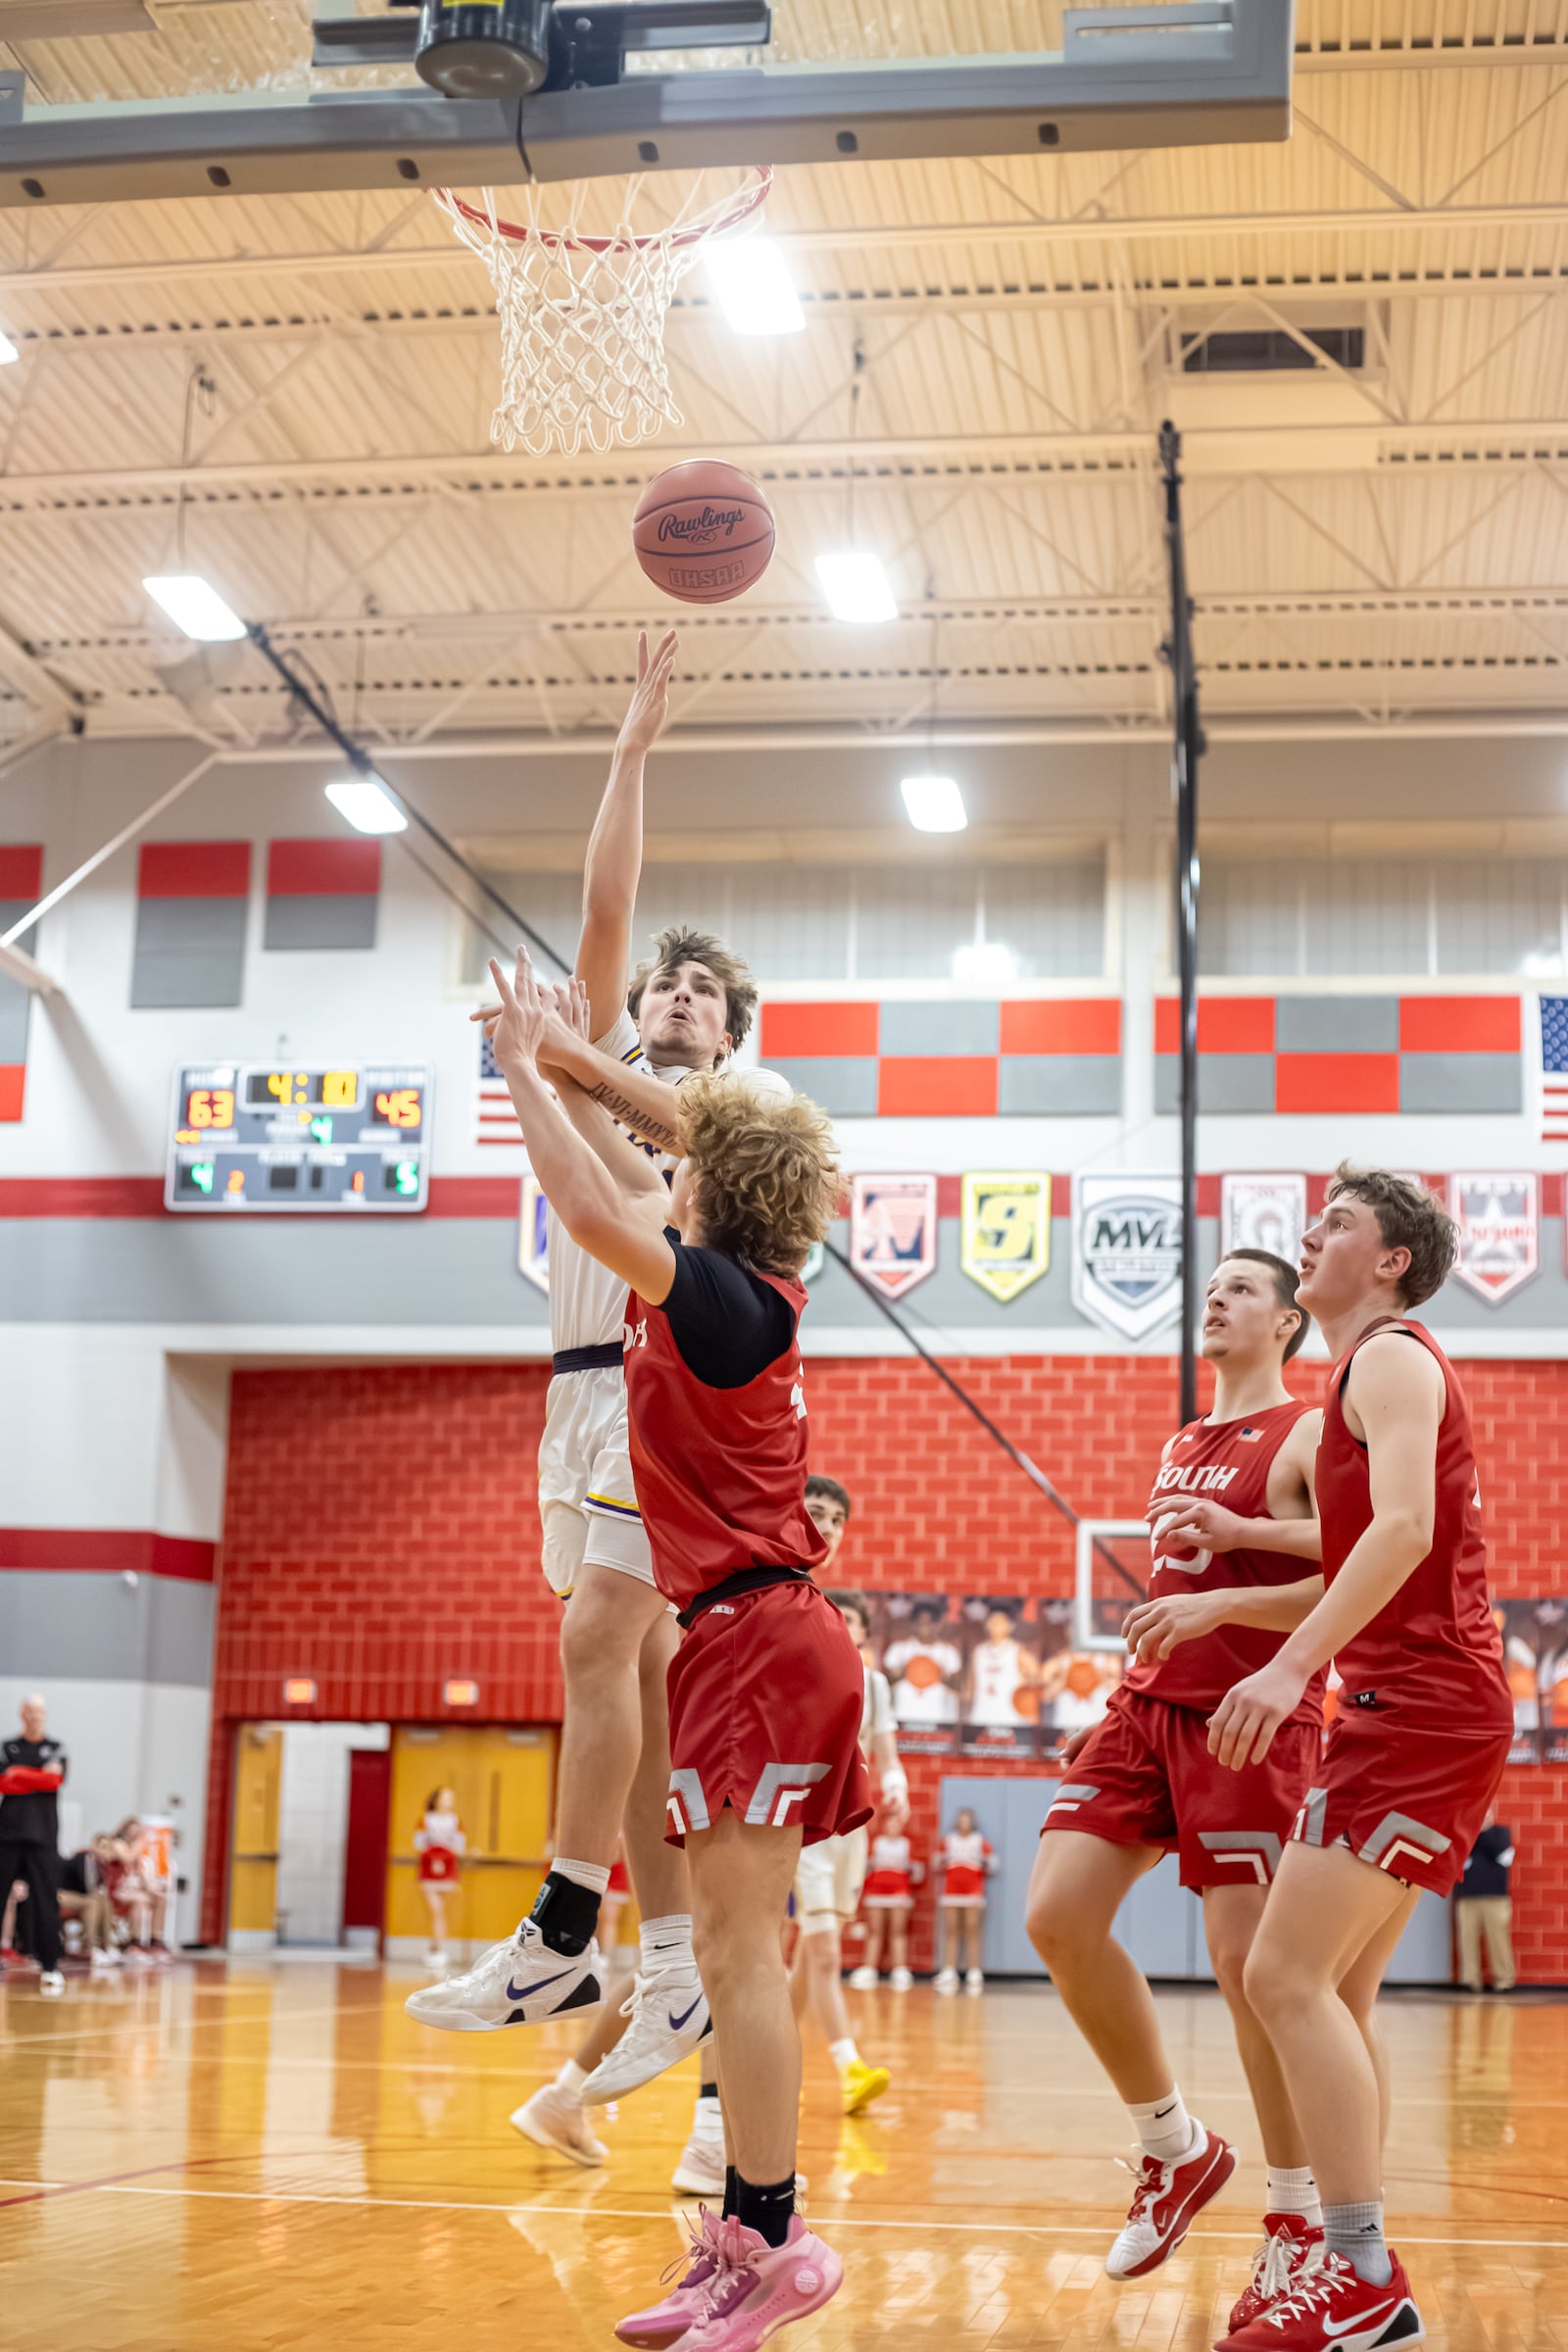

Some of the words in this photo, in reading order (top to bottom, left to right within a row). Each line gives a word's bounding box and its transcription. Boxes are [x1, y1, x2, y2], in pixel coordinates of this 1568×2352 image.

[658, 507, 745, 542] Rawlings
[668, 560, 745, 589] OHSAA
[187, 1090, 235, 1128] 63
[375, 1089, 421, 1128] 45
[311, 1115, 333, 1145] 4
[191, 1163, 214, 1193] 4
[1149, 1460, 1240, 1500] SOUTH
